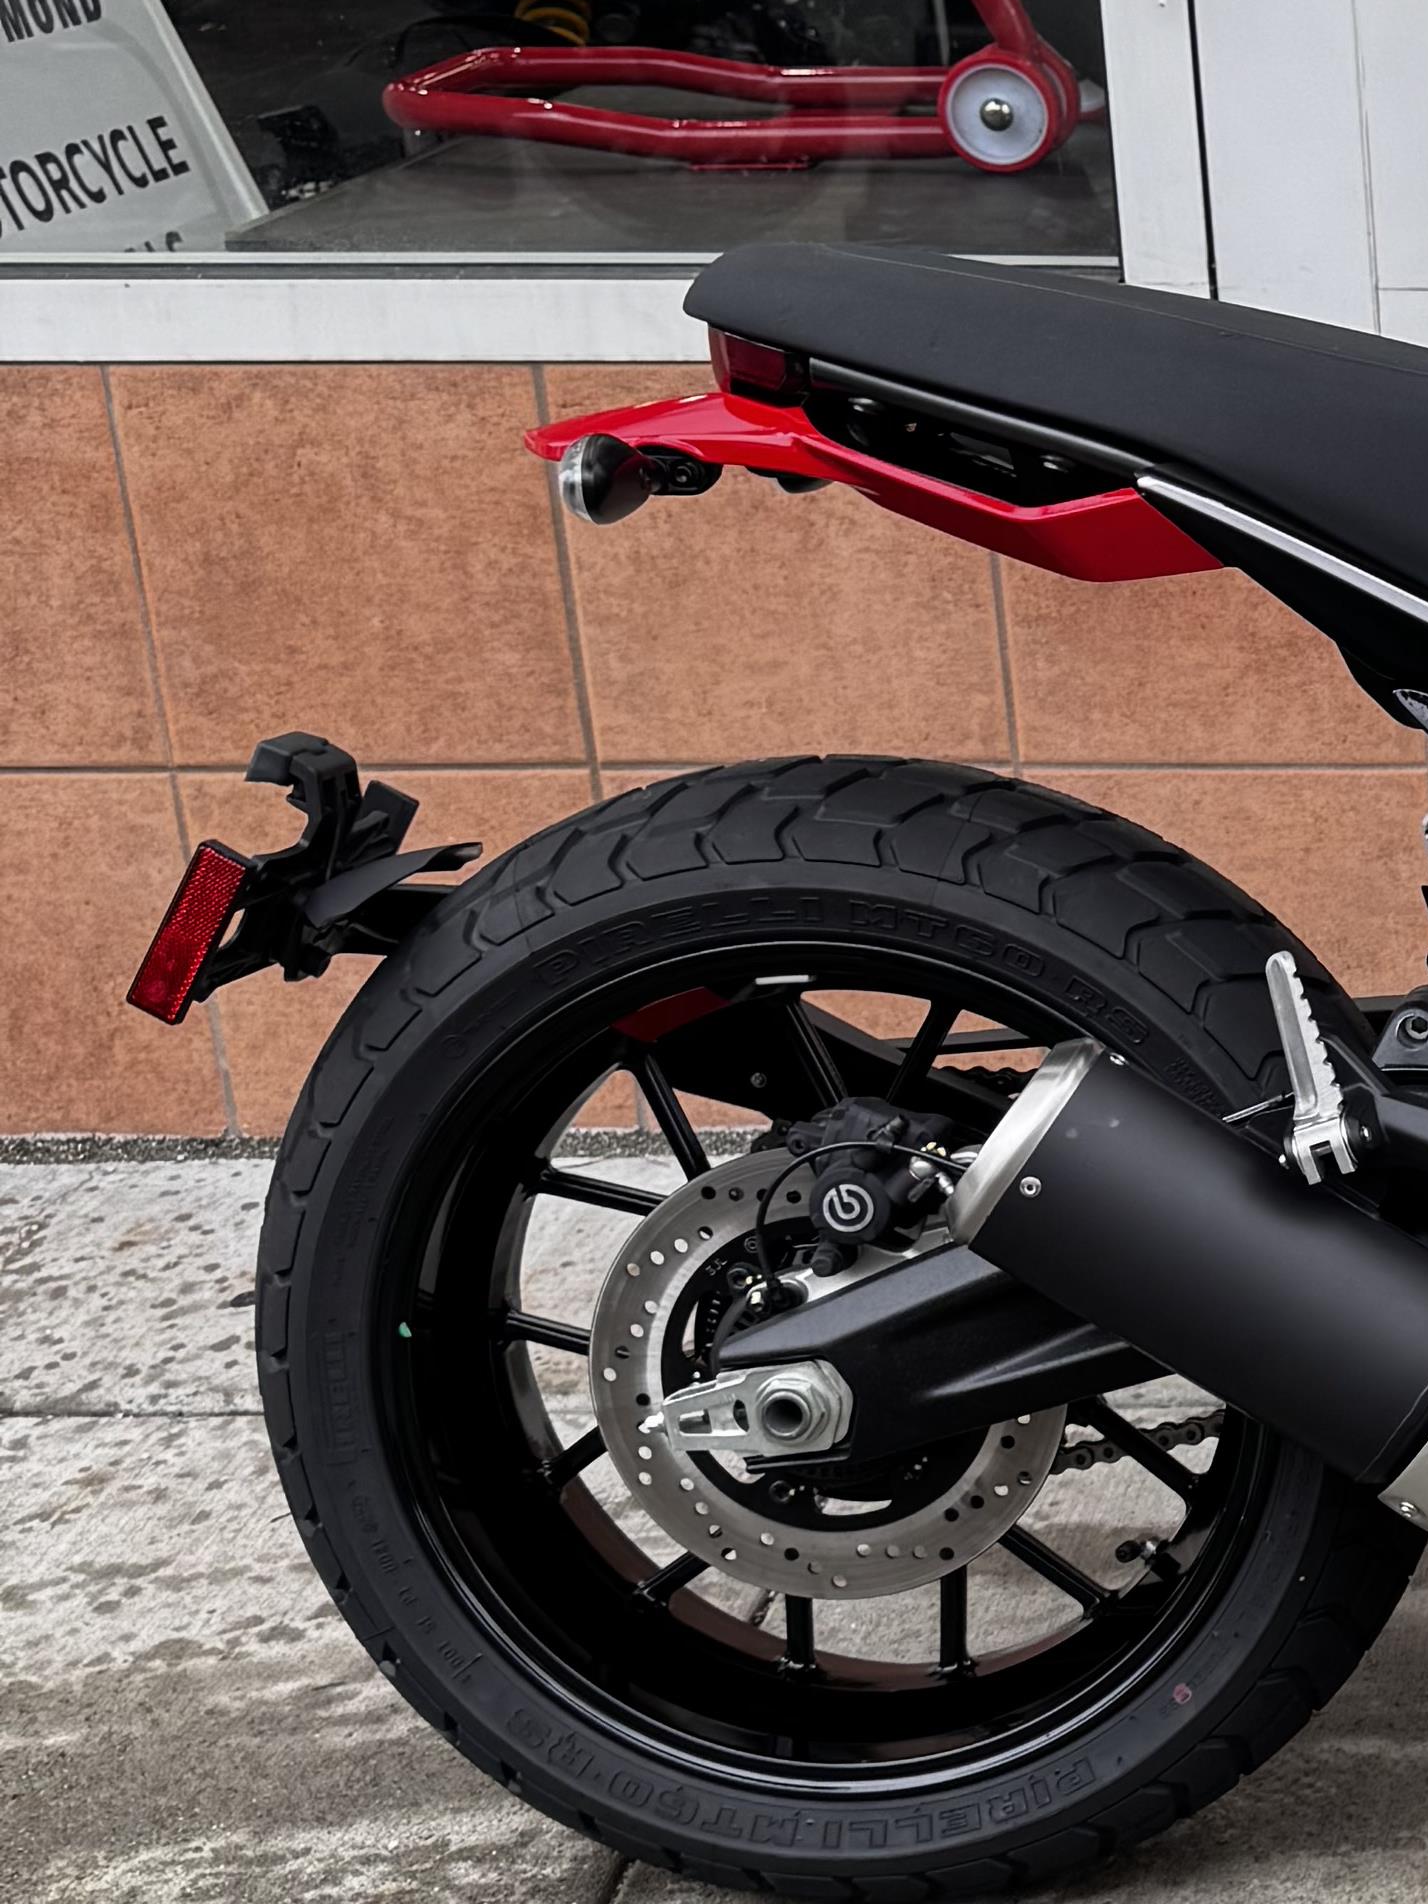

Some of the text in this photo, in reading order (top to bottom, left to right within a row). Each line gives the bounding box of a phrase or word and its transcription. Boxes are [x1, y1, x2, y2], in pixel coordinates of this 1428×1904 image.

[0, 114, 190, 239] TORCYCLE
[536, 897, 1149, 1044] PIRELLI MT60 RS
[504, 1708, 1095, 1849] PIRELLI MT60 RS
